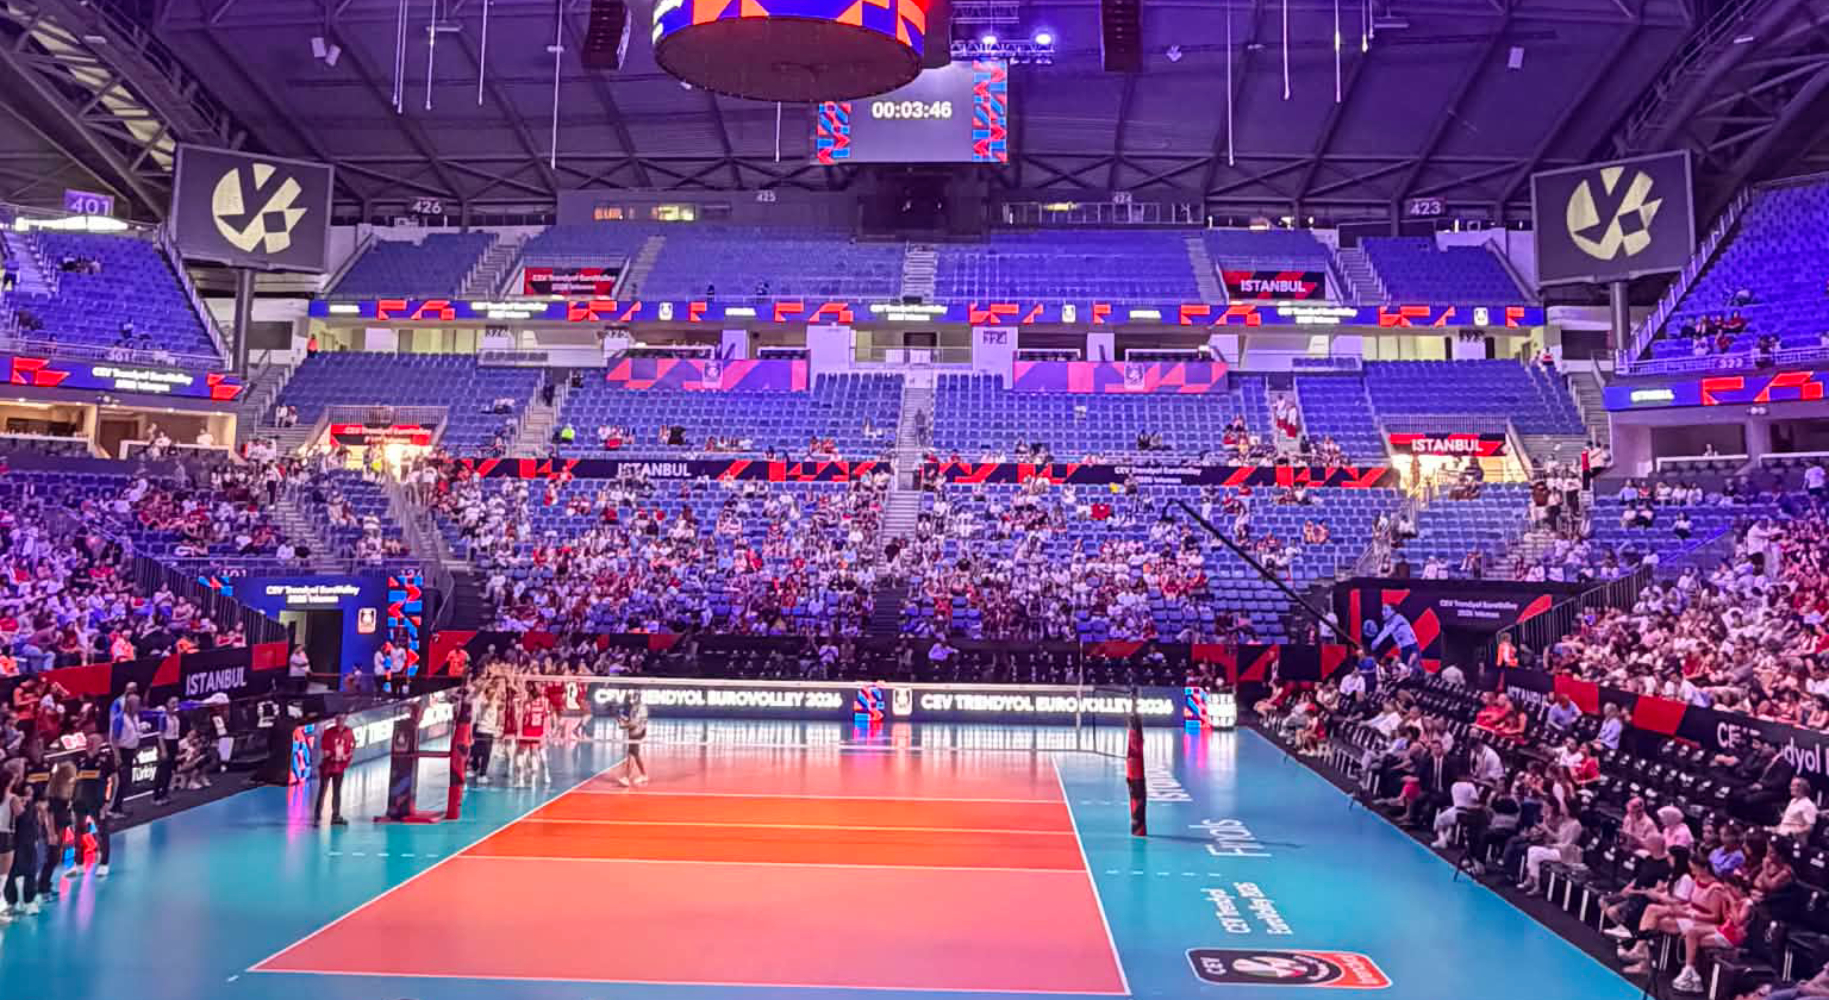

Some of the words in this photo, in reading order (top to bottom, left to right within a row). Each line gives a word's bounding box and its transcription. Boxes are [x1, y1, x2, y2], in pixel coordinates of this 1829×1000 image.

[872, 101, 952, 119] 00:03:46
[71, 197, 109, 214] 401
[412, 201, 442, 214] 426
[1410, 201, 1441, 215] 423
[1240, 279, 1306, 294] ISTANBUL
[1411, 437, 1484, 454] ISTANBUL
[617, 462, 692, 477] ISTANBUL
[185, 666, 248, 697] ISTANBUL
[594, 689, 625, 704] CEV
[707, 690, 803, 707] EUROVOLLEY
[804, 691, 843, 707] 2026
[921, 693, 952, 711] CEV
[953, 693, 1035, 712] TRENDYOL
[1036, 694, 1133, 714] EUROVOLLEY
[1136, 699, 1175, 715] 2026
[1188, 818, 1273, 858] Finals
[1200, 956, 1228, 975] CEV
